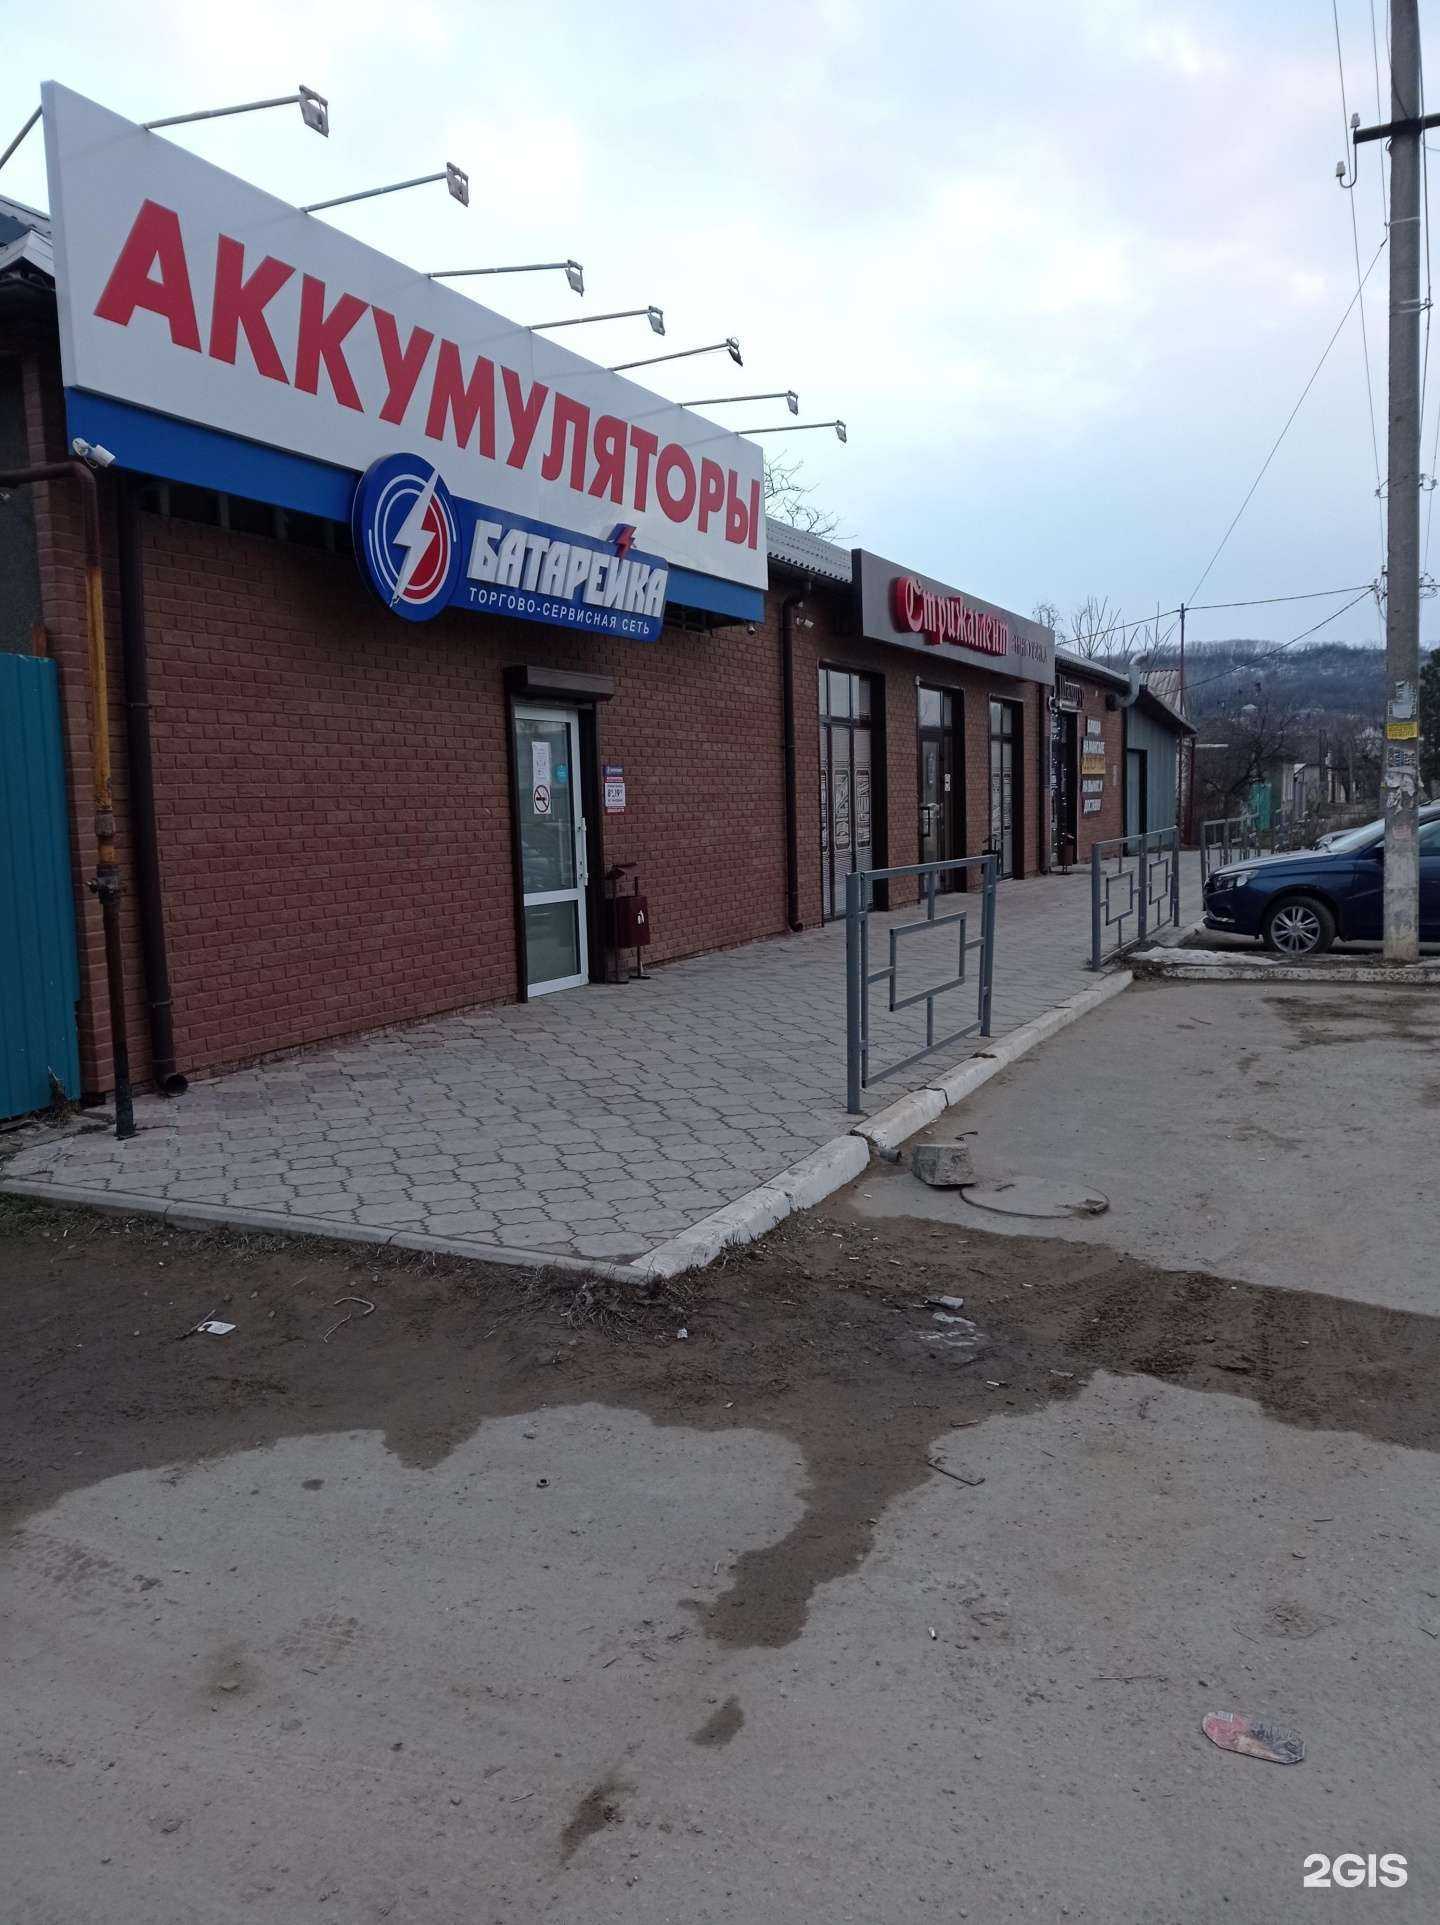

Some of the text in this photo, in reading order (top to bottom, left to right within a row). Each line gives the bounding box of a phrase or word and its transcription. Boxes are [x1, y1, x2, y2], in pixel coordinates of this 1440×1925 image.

[94, 198, 761, 550] АККУМУЛЯТОРЫ
[467, 519, 669, 618] БАТАРЕЙКА
[469, 587, 650, 634] ТОРГОВО-СЕРВИСНАЯ СЕТЬ
